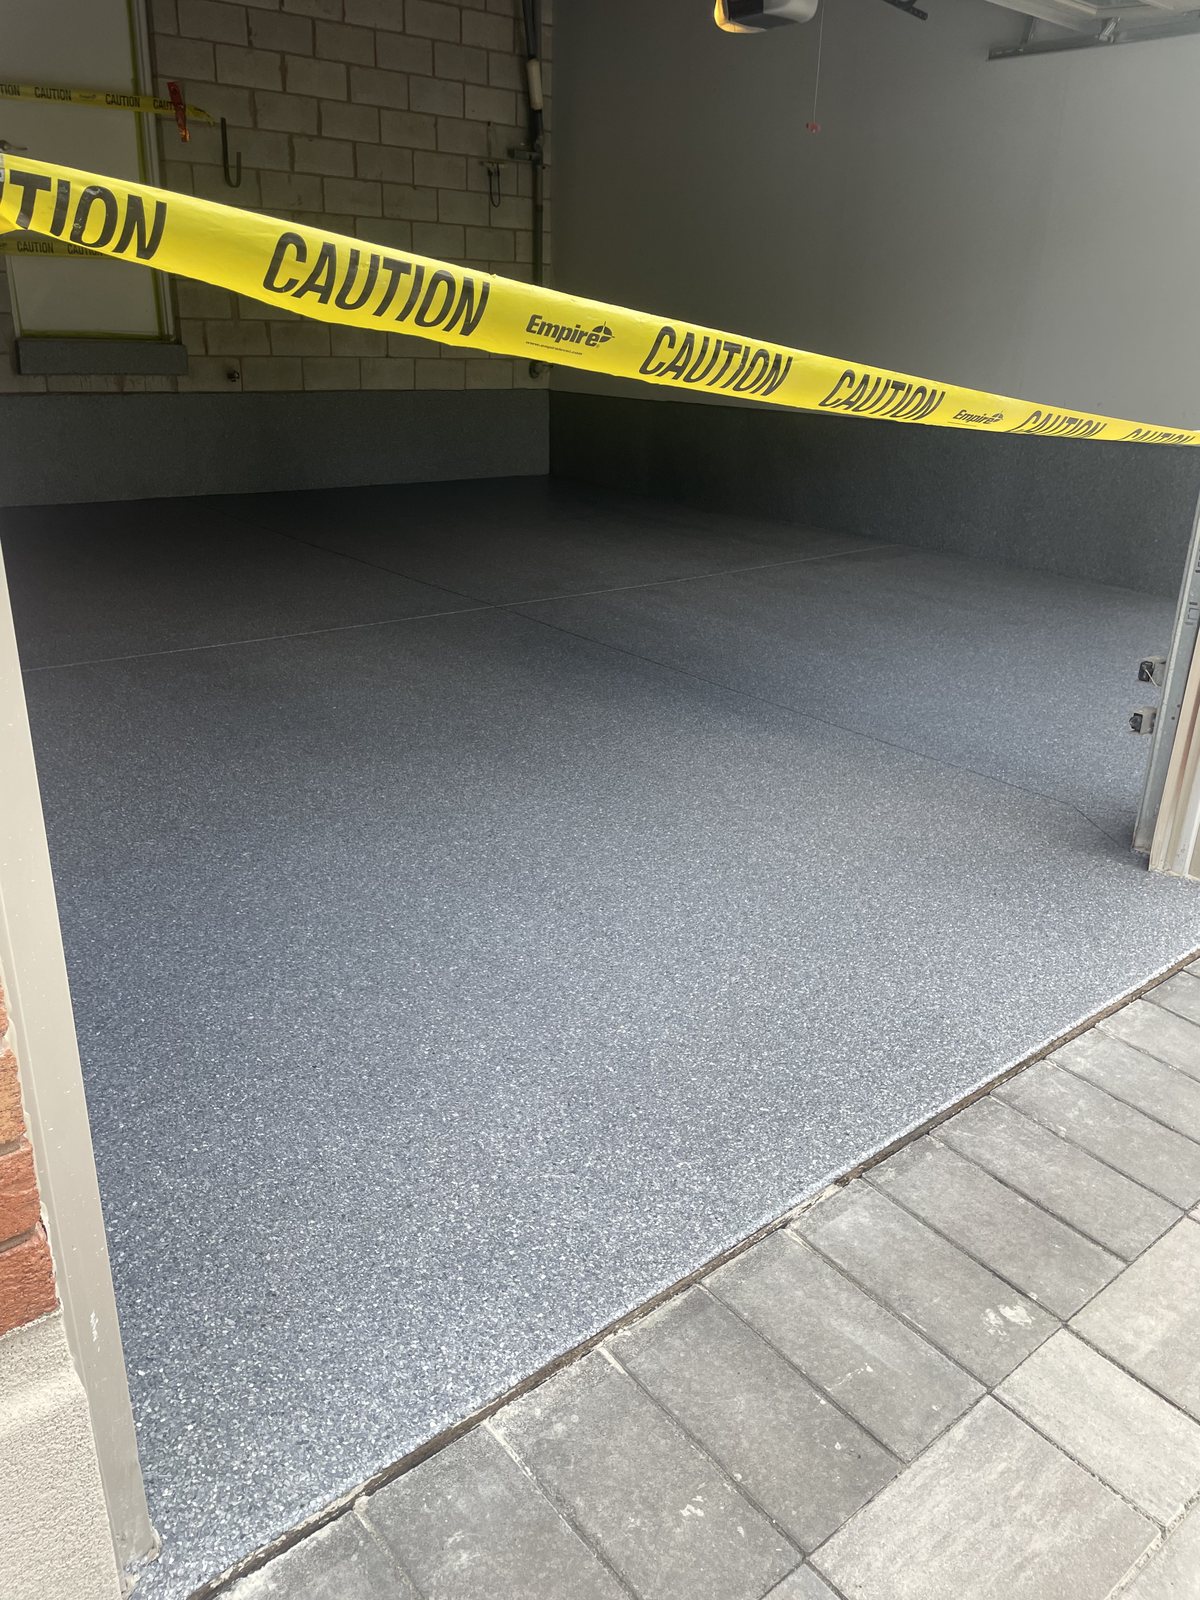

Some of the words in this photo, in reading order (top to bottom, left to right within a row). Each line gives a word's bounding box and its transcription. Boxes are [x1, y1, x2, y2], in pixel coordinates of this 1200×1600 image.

[34, 86, 72, 101] CAUTION
[105, 94, 140, 108] CAUTION
[153, 98, 174, 111] CAUT
[17, 241, 54, 253] CAUTION
[0, 168, 167, 260] TION
[263, 232, 490, 336] CAUTION
[525, 314, 600, 347] Empire
[639, 326, 793, 397] CAUTION
[818, 369, 946, 420] CAUTION
[953, 409, 994, 424] Empire
[1004, 410, 1107, 437] CAUTION
[1122, 428, 1196, 443] CAUTION
